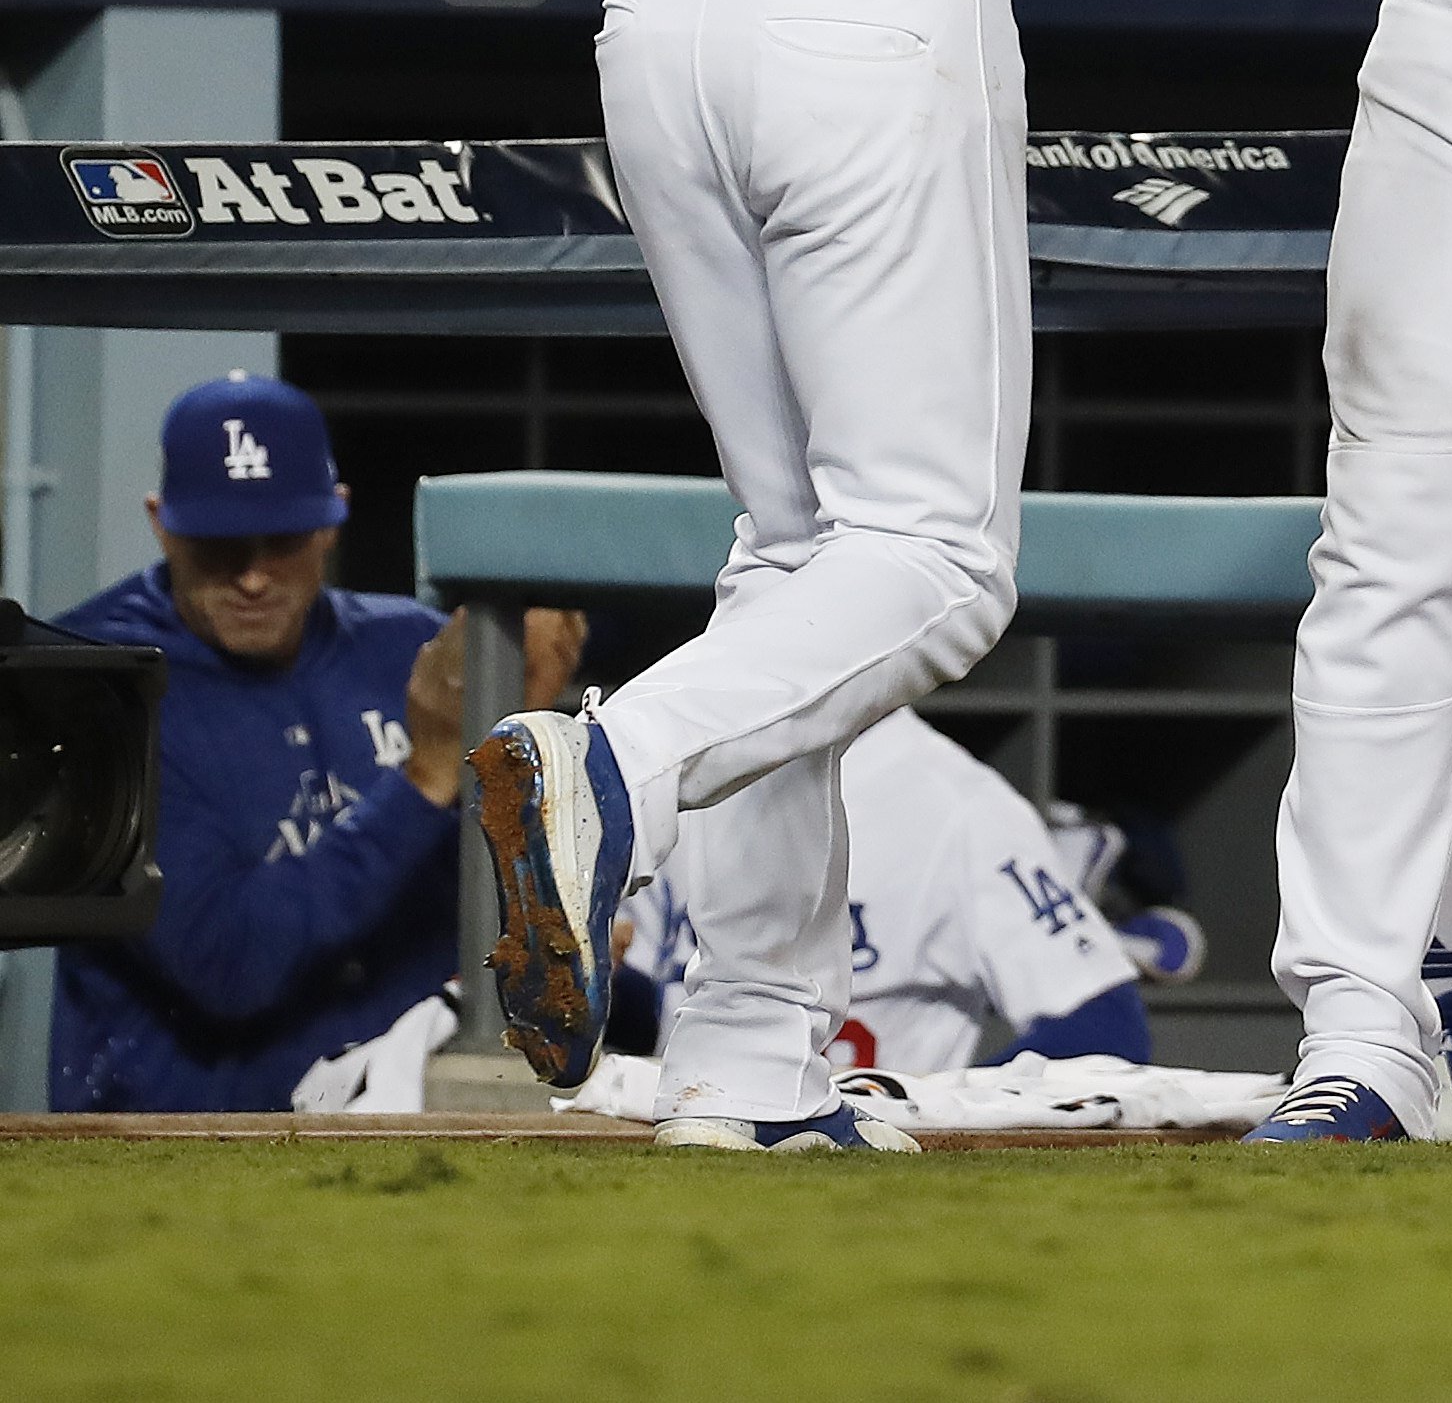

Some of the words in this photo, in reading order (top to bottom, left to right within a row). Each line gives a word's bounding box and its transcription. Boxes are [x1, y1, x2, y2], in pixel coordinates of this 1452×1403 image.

[1026, 136, 1092, 170] ank
[1130, 138, 1289, 172] America
[91, 203, 189, 225] MLB.com
[184, 156, 310, 225] At
[293, 158, 481, 223] Bat
[224, 419, 271, 480] LA
[998, 859, 1087, 936] LA
